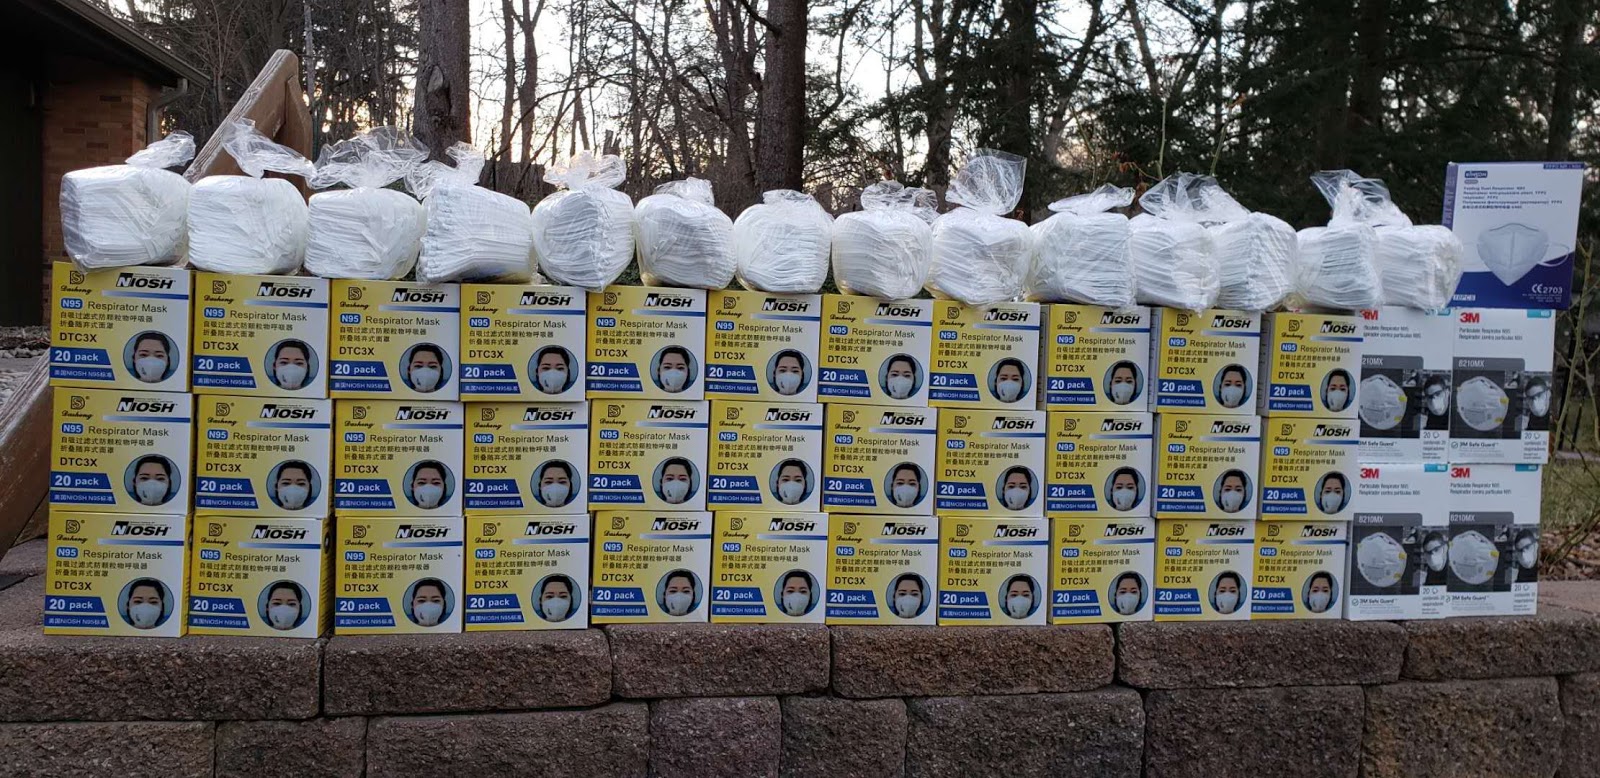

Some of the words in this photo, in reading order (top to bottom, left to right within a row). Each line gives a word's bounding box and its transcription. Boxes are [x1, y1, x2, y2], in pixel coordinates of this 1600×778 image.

[116, 272, 174, 289] NIOSH
[1543, 286, 1562, 294] 2703
[392, 288, 446, 303] NIOSH
[644, 293, 693, 307] NIOSH
[62, 299, 81, 308] N95
[88, 301, 138, 312] Respirator
[142, 304, 167, 313] Mask
[762, 298, 809, 312] NIOSH
[875, 303, 921, 317] NIOSH
[365, 316, 412, 326] Respirator
[416, 317, 440, 326] Mask
[1100, 311, 1143, 325] NIOSH
[1211, 315, 1253, 329] NIOSH
[1460, 312, 1480, 323] 3M
[620, 319, 663, 329] Respirator
[666, 321, 688, 329] Mask
[203, 341, 239, 351] DTC3X
[1078, 337, 1116, 345] Respirator
[469, 350, 503, 358] DTC3X
[714, 352, 745, 360] DTC3X
[938, 360, 967, 368] DTC3X
[465, 367, 480, 377] 20
[483, 368, 505, 377] pack
[823, 371, 836, 381] 20
[839, 372, 858, 381] pack
[933, 376, 946, 385] 20
[949, 377, 968, 385] pack
[1162, 382, 1175, 392] 20
[1177, 383, 1195, 392] pack
[1274, 387, 1285, 396] 20
[1287, 388, 1304, 396] pack
[260, 404, 315, 419] NIOSH
[396, 406, 449, 420] NIOSH
[523, 407, 574, 421] NIOSH
[765, 408, 811, 422] NIOSH
[880, 412, 926, 426] NIOSH
[992, 417, 1036, 430] NIOSH
[1100, 418, 1143, 431] NIOSH
[1210, 421, 1253, 434] NIOSH
[208, 431, 226, 439] N95
[233, 432, 281, 442] Respirator
[284, 434, 309, 442] Mask
[498, 435, 543, 444] Respirator
[741, 434, 782, 443] Respirator
[969, 442, 1008, 451] Respirator
[344, 465, 378, 473] DTC3X
[599, 461, 630, 469] DTC3X
[1056, 472, 1085, 480] DTC3X
[1360, 468, 1379, 479] 3M
[1451, 468, 1470, 478] 3M
[55, 475, 71, 486] 20
[75, 476, 99, 486] pack
[829, 481, 842, 490] 20
[845, 482, 864, 491] pack
[1162, 488, 1175, 497] 20
[1177, 489, 1195, 498] pack
[1267, 491, 1279, 499] 20
[1281, 491, 1297, 499] pack
[1359, 515, 1383, 523] 8210MX
[1450, 514, 1475, 522] 8210MX
[111, 521, 169, 536] NIOSH
[525, 520, 576, 536] NIOSH
[651, 517, 700, 531] NIOSH
[768, 518, 816, 531] NIOSH
[881, 522, 928, 536] NIOSH
[395, 523, 449, 539] NIOSH
[1104, 523, 1146, 536] NIOSH
[1206, 524, 1246, 536] NIOSH
[627, 544, 669, 553] Respirator
[1083, 548, 1119, 557] Respirator
[83, 549, 133, 560] Respirator
[137, 551, 162, 560] Mask
[370, 552, 416, 562] Respirator
[721, 574, 752, 582] DTC3X
[1258, 575, 1285, 583] DTC3X
[199, 583, 233, 592] DTC3X
[830, 593, 844, 602] 20
[847, 594, 866, 602] pack
[944, 595, 957, 604] 20
[960, 595, 979, 604] pack
[1160, 591, 1172, 601] 20
[1174, 592, 1191, 600] pack
[1254, 591, 1266, 600] 20
[1268, 591, 1285, 599] pack
[470, 598, 485, 608] 20
[488, 598, 509, 608] pack
